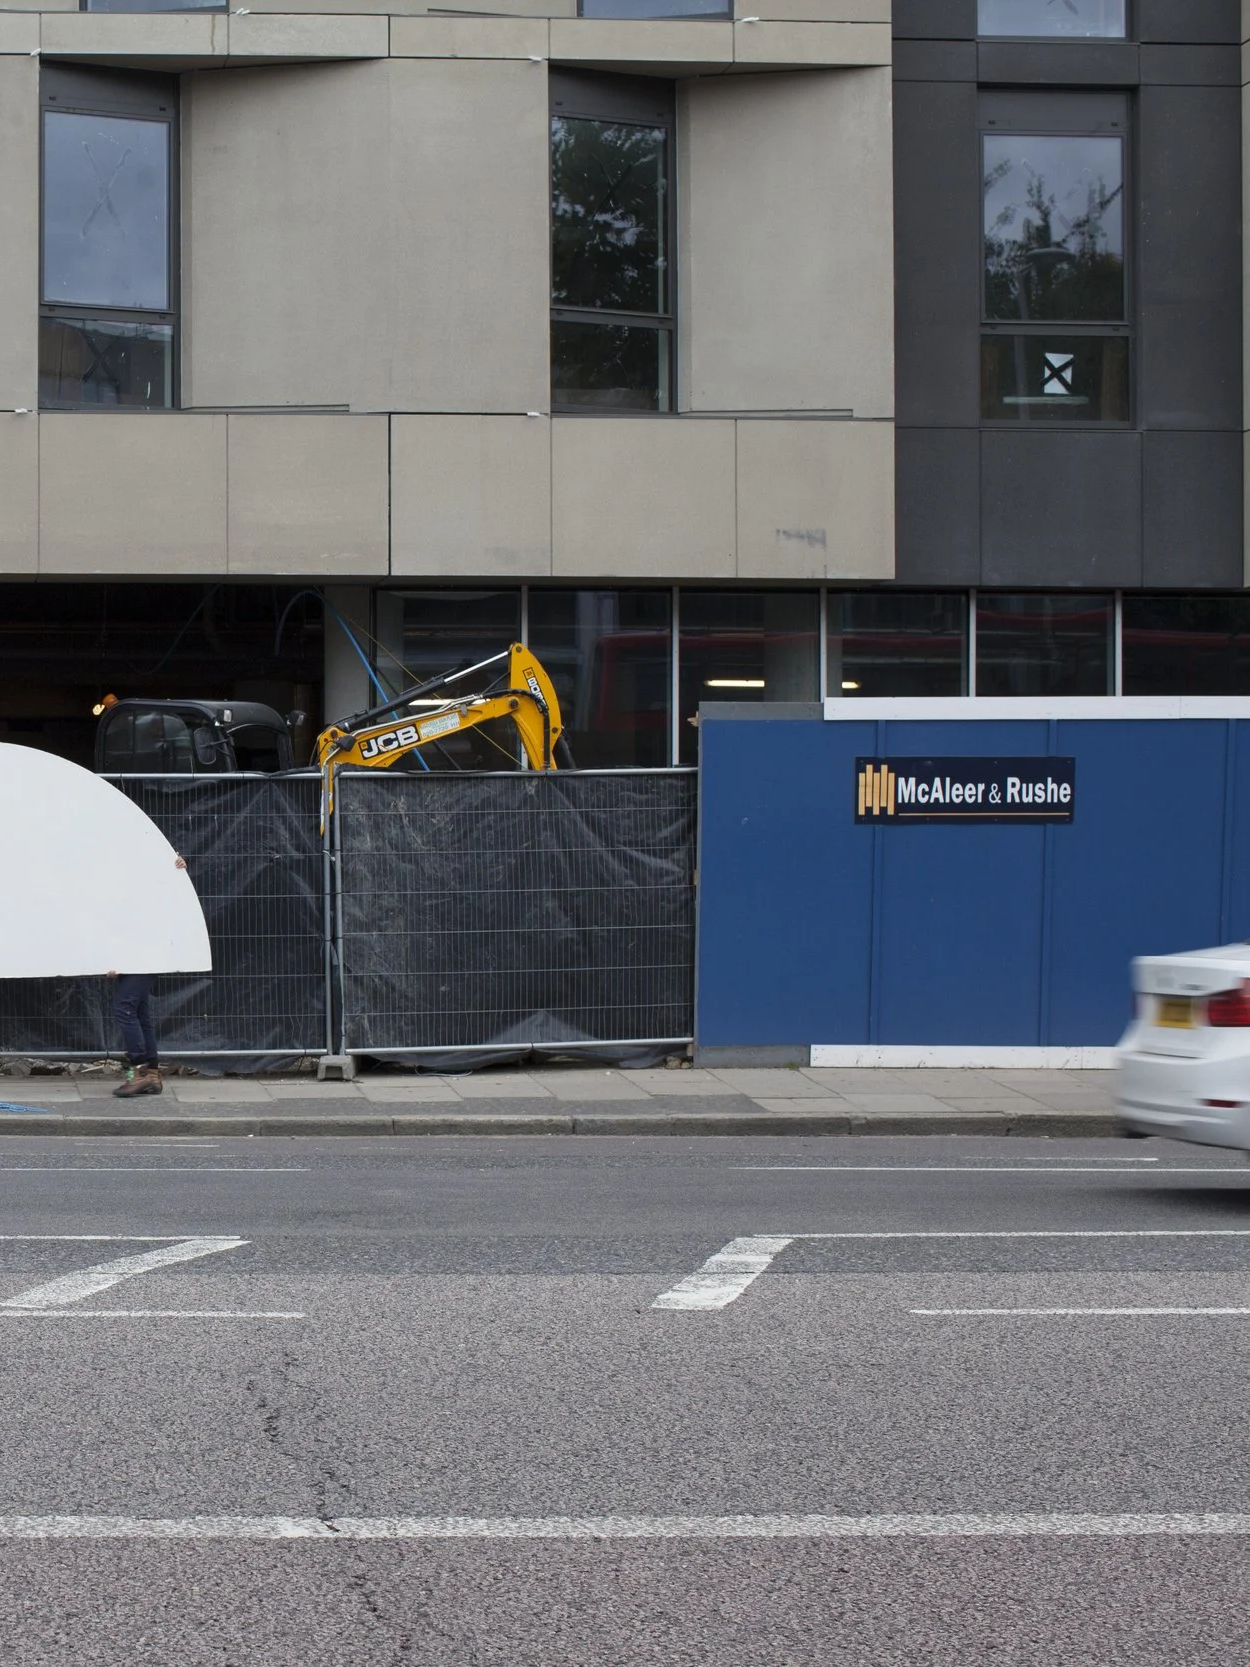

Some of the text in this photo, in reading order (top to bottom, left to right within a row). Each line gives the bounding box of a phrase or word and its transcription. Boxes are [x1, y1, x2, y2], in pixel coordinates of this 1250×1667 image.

[362, 725, 419, 758] JCB
[898, 777, 1071, 804] McAleer & Rushe
